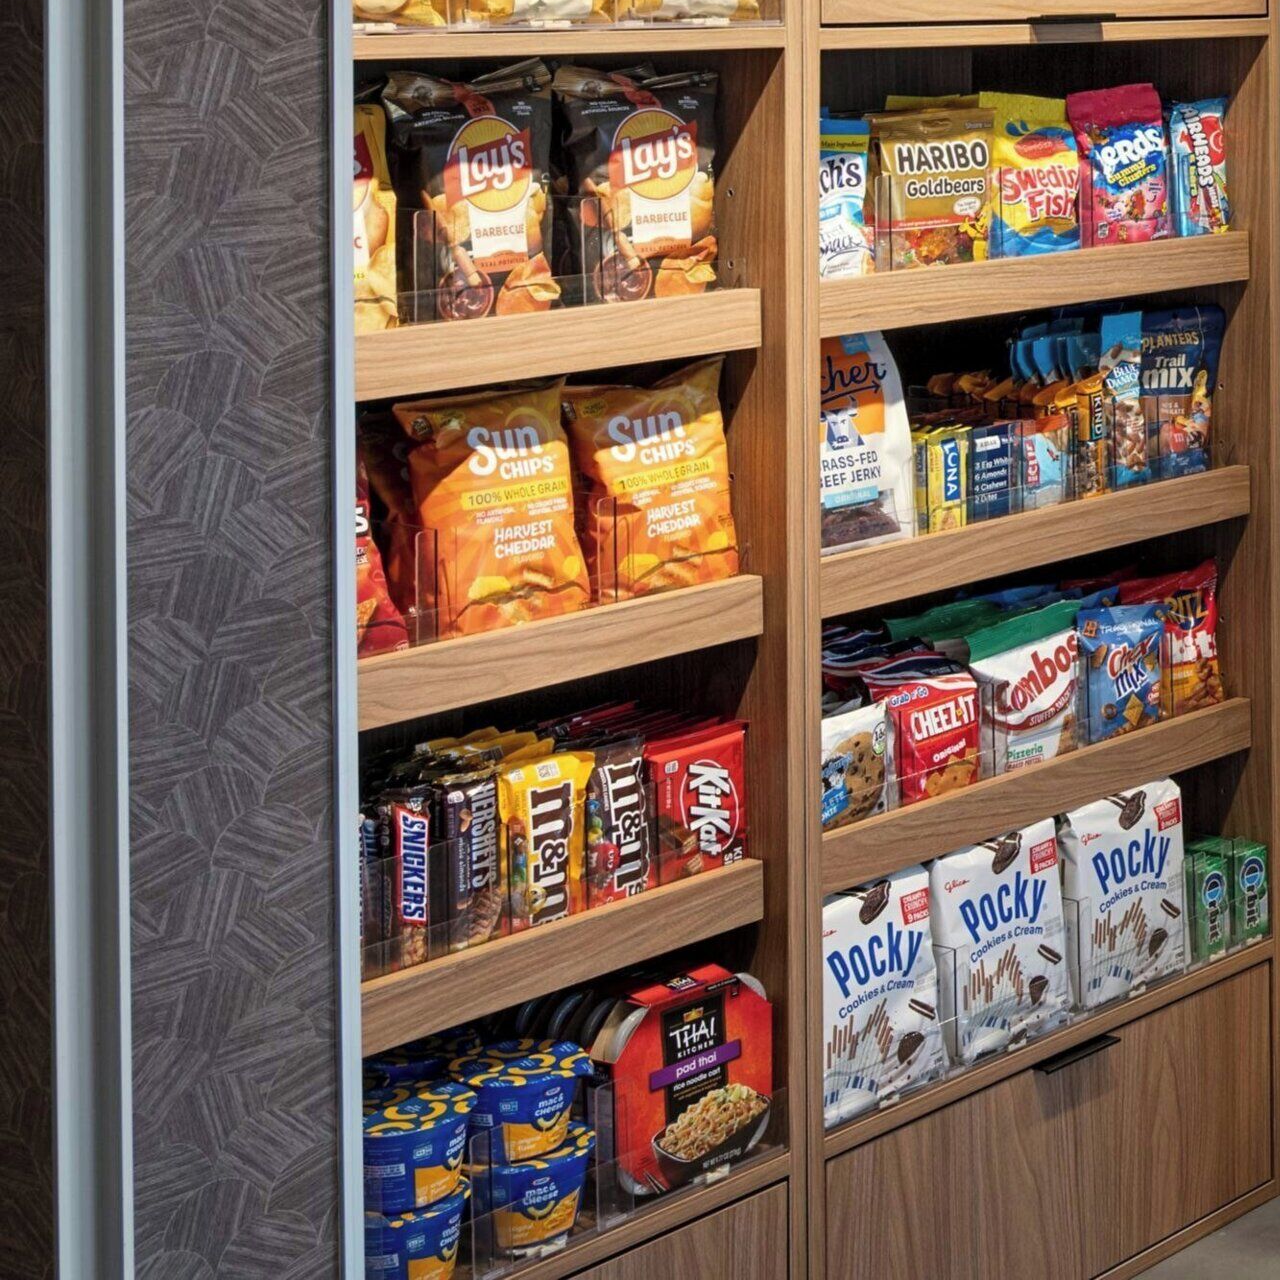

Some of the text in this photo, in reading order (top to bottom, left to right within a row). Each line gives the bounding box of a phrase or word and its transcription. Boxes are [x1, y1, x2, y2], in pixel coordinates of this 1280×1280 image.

[458, 134, 525, 197] Lay's
[621, 126, 692, 185] Lay's
[896, 140, 988, 173] HARIBO
[820, 157, 862, 196] ch's
[906, 179, 985, 198] Goldbears
[475, 223, 525, 239] BARBECUE
[635, 211, 689, 225] BARBECUE
[1142, 331, 1200, 353] PLANTERS
[1155, 354, 1187, 368] Trail
[1093, 396, 1103, 434] KIND
[608, 411, 686, 463] Sun
[466, 426, 544, 476] Sun
[639, 439, 696, 465] CHIPS
[822, 451, 878, 472] RASS-FED
[500, 456, 555, 480] CHIPS
[618, 461, 710, 491] 100% WHOLE GRAIN
[850, 466, 882, 486] JERKY
[943, 441, 958, 497] LUNA
[468, 480, 567, 507] 100% WHOLE GRAIN
[647, 499, 696, 524] HARVEST
[494, 520, 554, 545] HARVEST
[647, 514, 702, 538] CHEDDAR
[495, 535, 557, 559] CHEDDAR
[1162, 591, 1209, 625] RITZ
[889, 686, 929, 707] Grab Go
[1006, 743, 1044, 761] Pizzeria
[402, 815, 427, 921] SNICKERS
[1099, 887, 1133, 914] Cookies
[1140, 879, 1168, 891] Cream
[970, 938, 1007, 964] Cookies
[1014, 924, 1043, 937] Cream
[838, 988, 881, 1020] Cookies
[887, 978, 915, 991] Cream
[668, 1016, 716, 1050] THAI
[677, 1039, 715, 1059] KITCHEN
[675, 1051, 718, 1079] pad thai
[673, 1081, 685, 1092] rice
